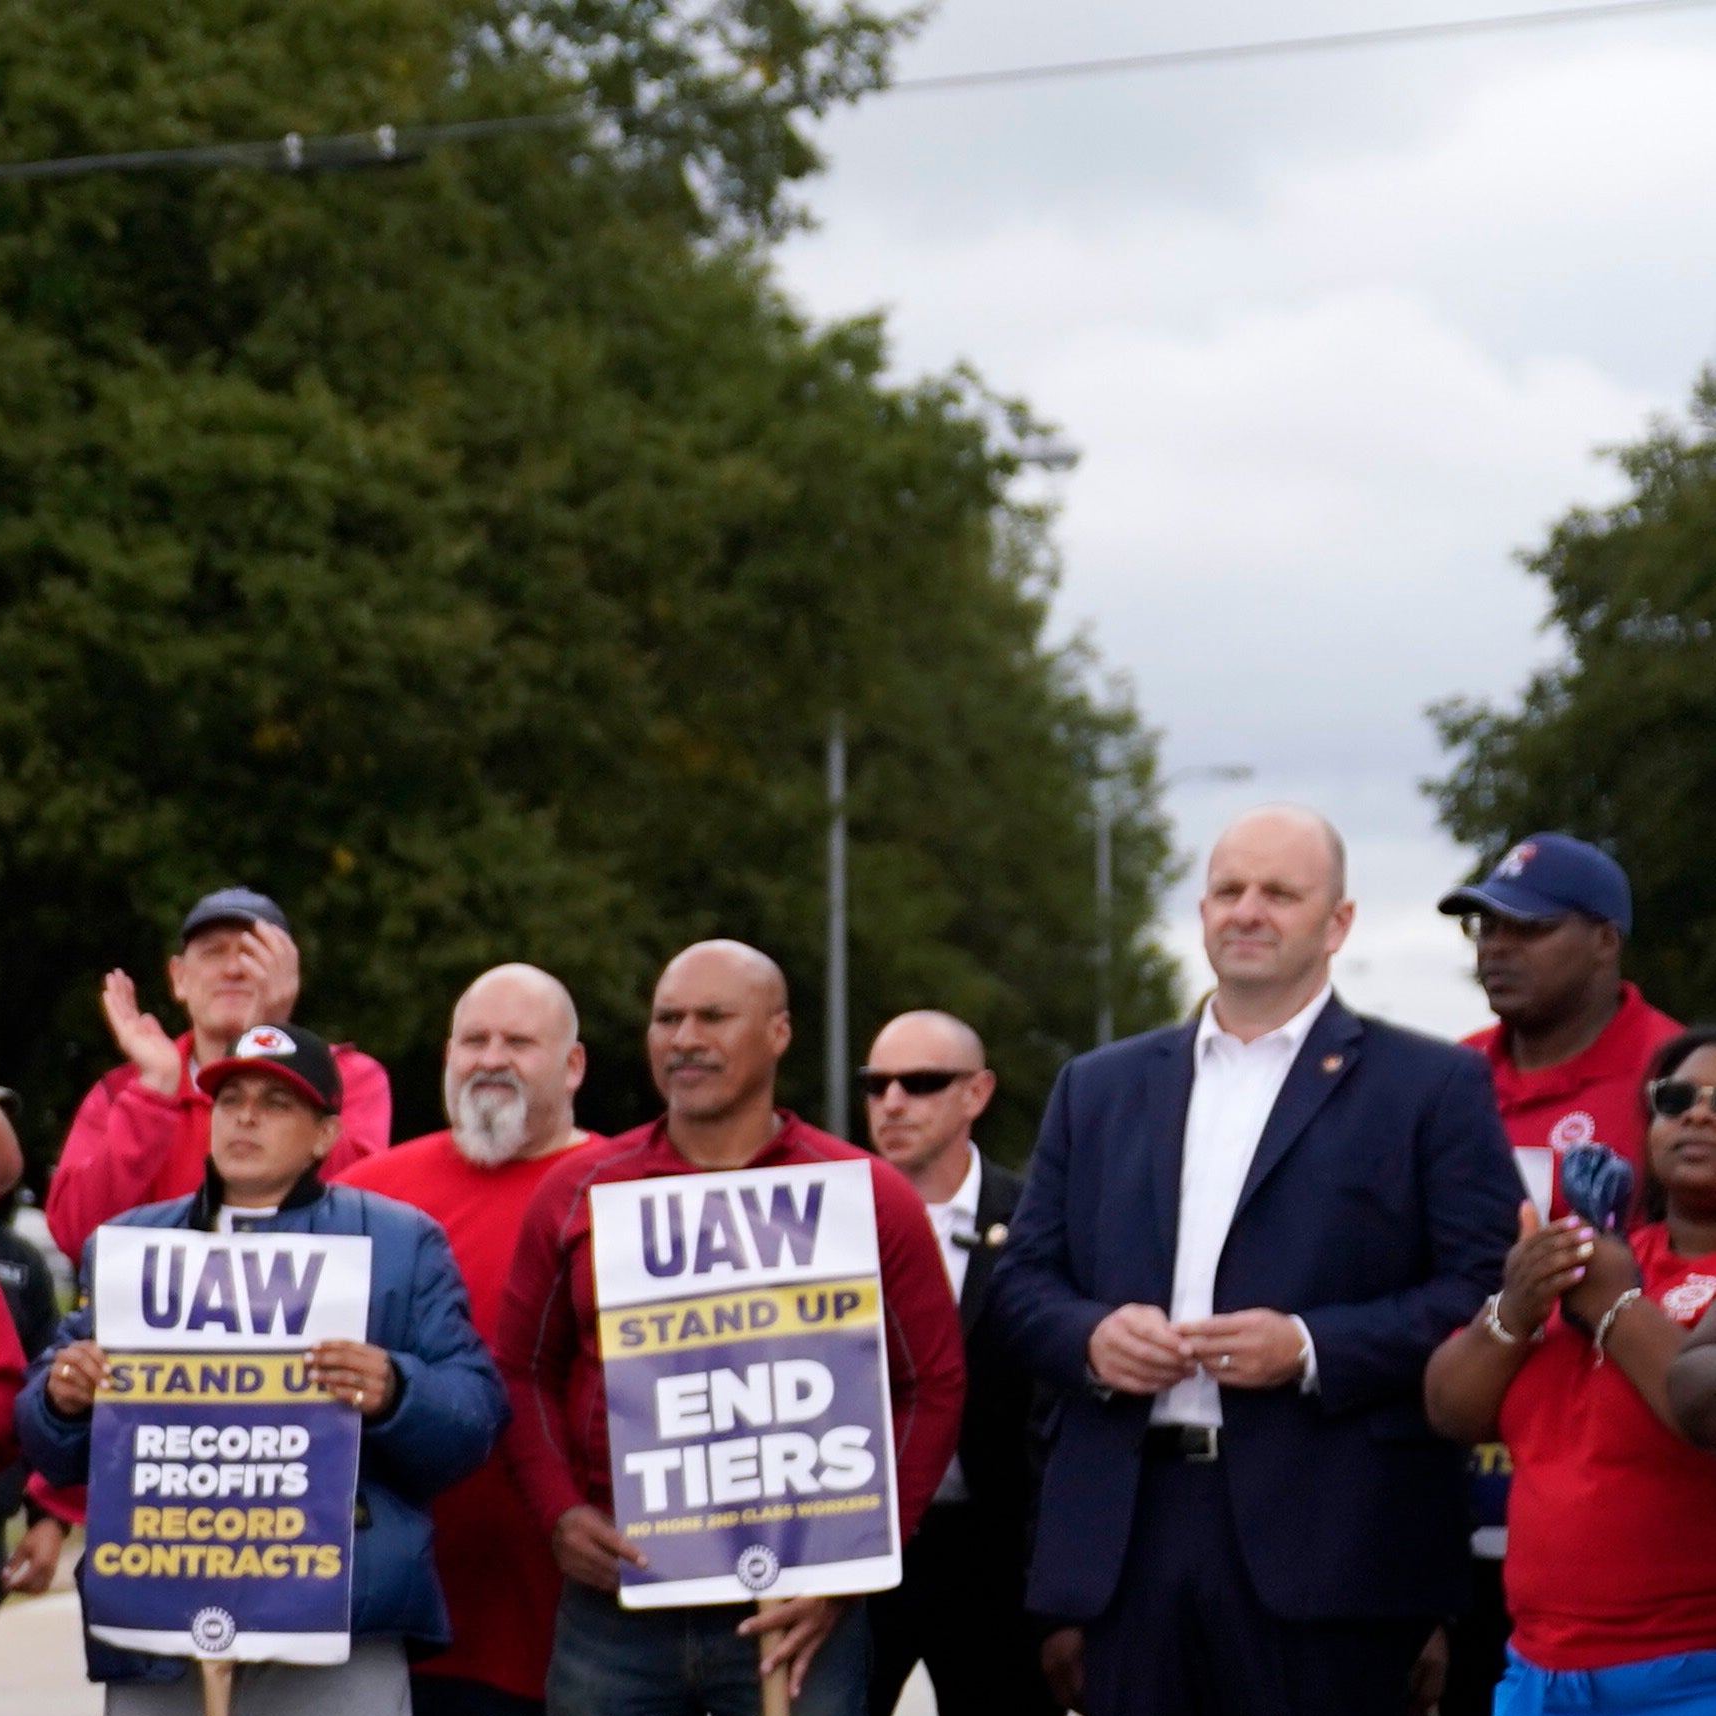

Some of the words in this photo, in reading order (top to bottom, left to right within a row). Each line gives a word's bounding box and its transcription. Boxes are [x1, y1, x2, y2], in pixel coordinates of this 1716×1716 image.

[640, 1181, 826, 1279] UAW
[142, 1244, 327, 1336] UAW
[619, 1298, 780, 1350] STAND
[797, 1291, 862, 1324] UP
[111, 1363, 265, 1394] STAND
[283, 1364, 329, 1394] U
[656, 1358, 835, 1440] END
[135, 1424, 310, 1461] RECORD
[133, 1462, 309, 1499] PROFITS
[624, 1425, 876, 1514] TIERS
[132, 1506, 307, 1541] RECORD
[92, 1541, 343, 1581] CONTRACTS
